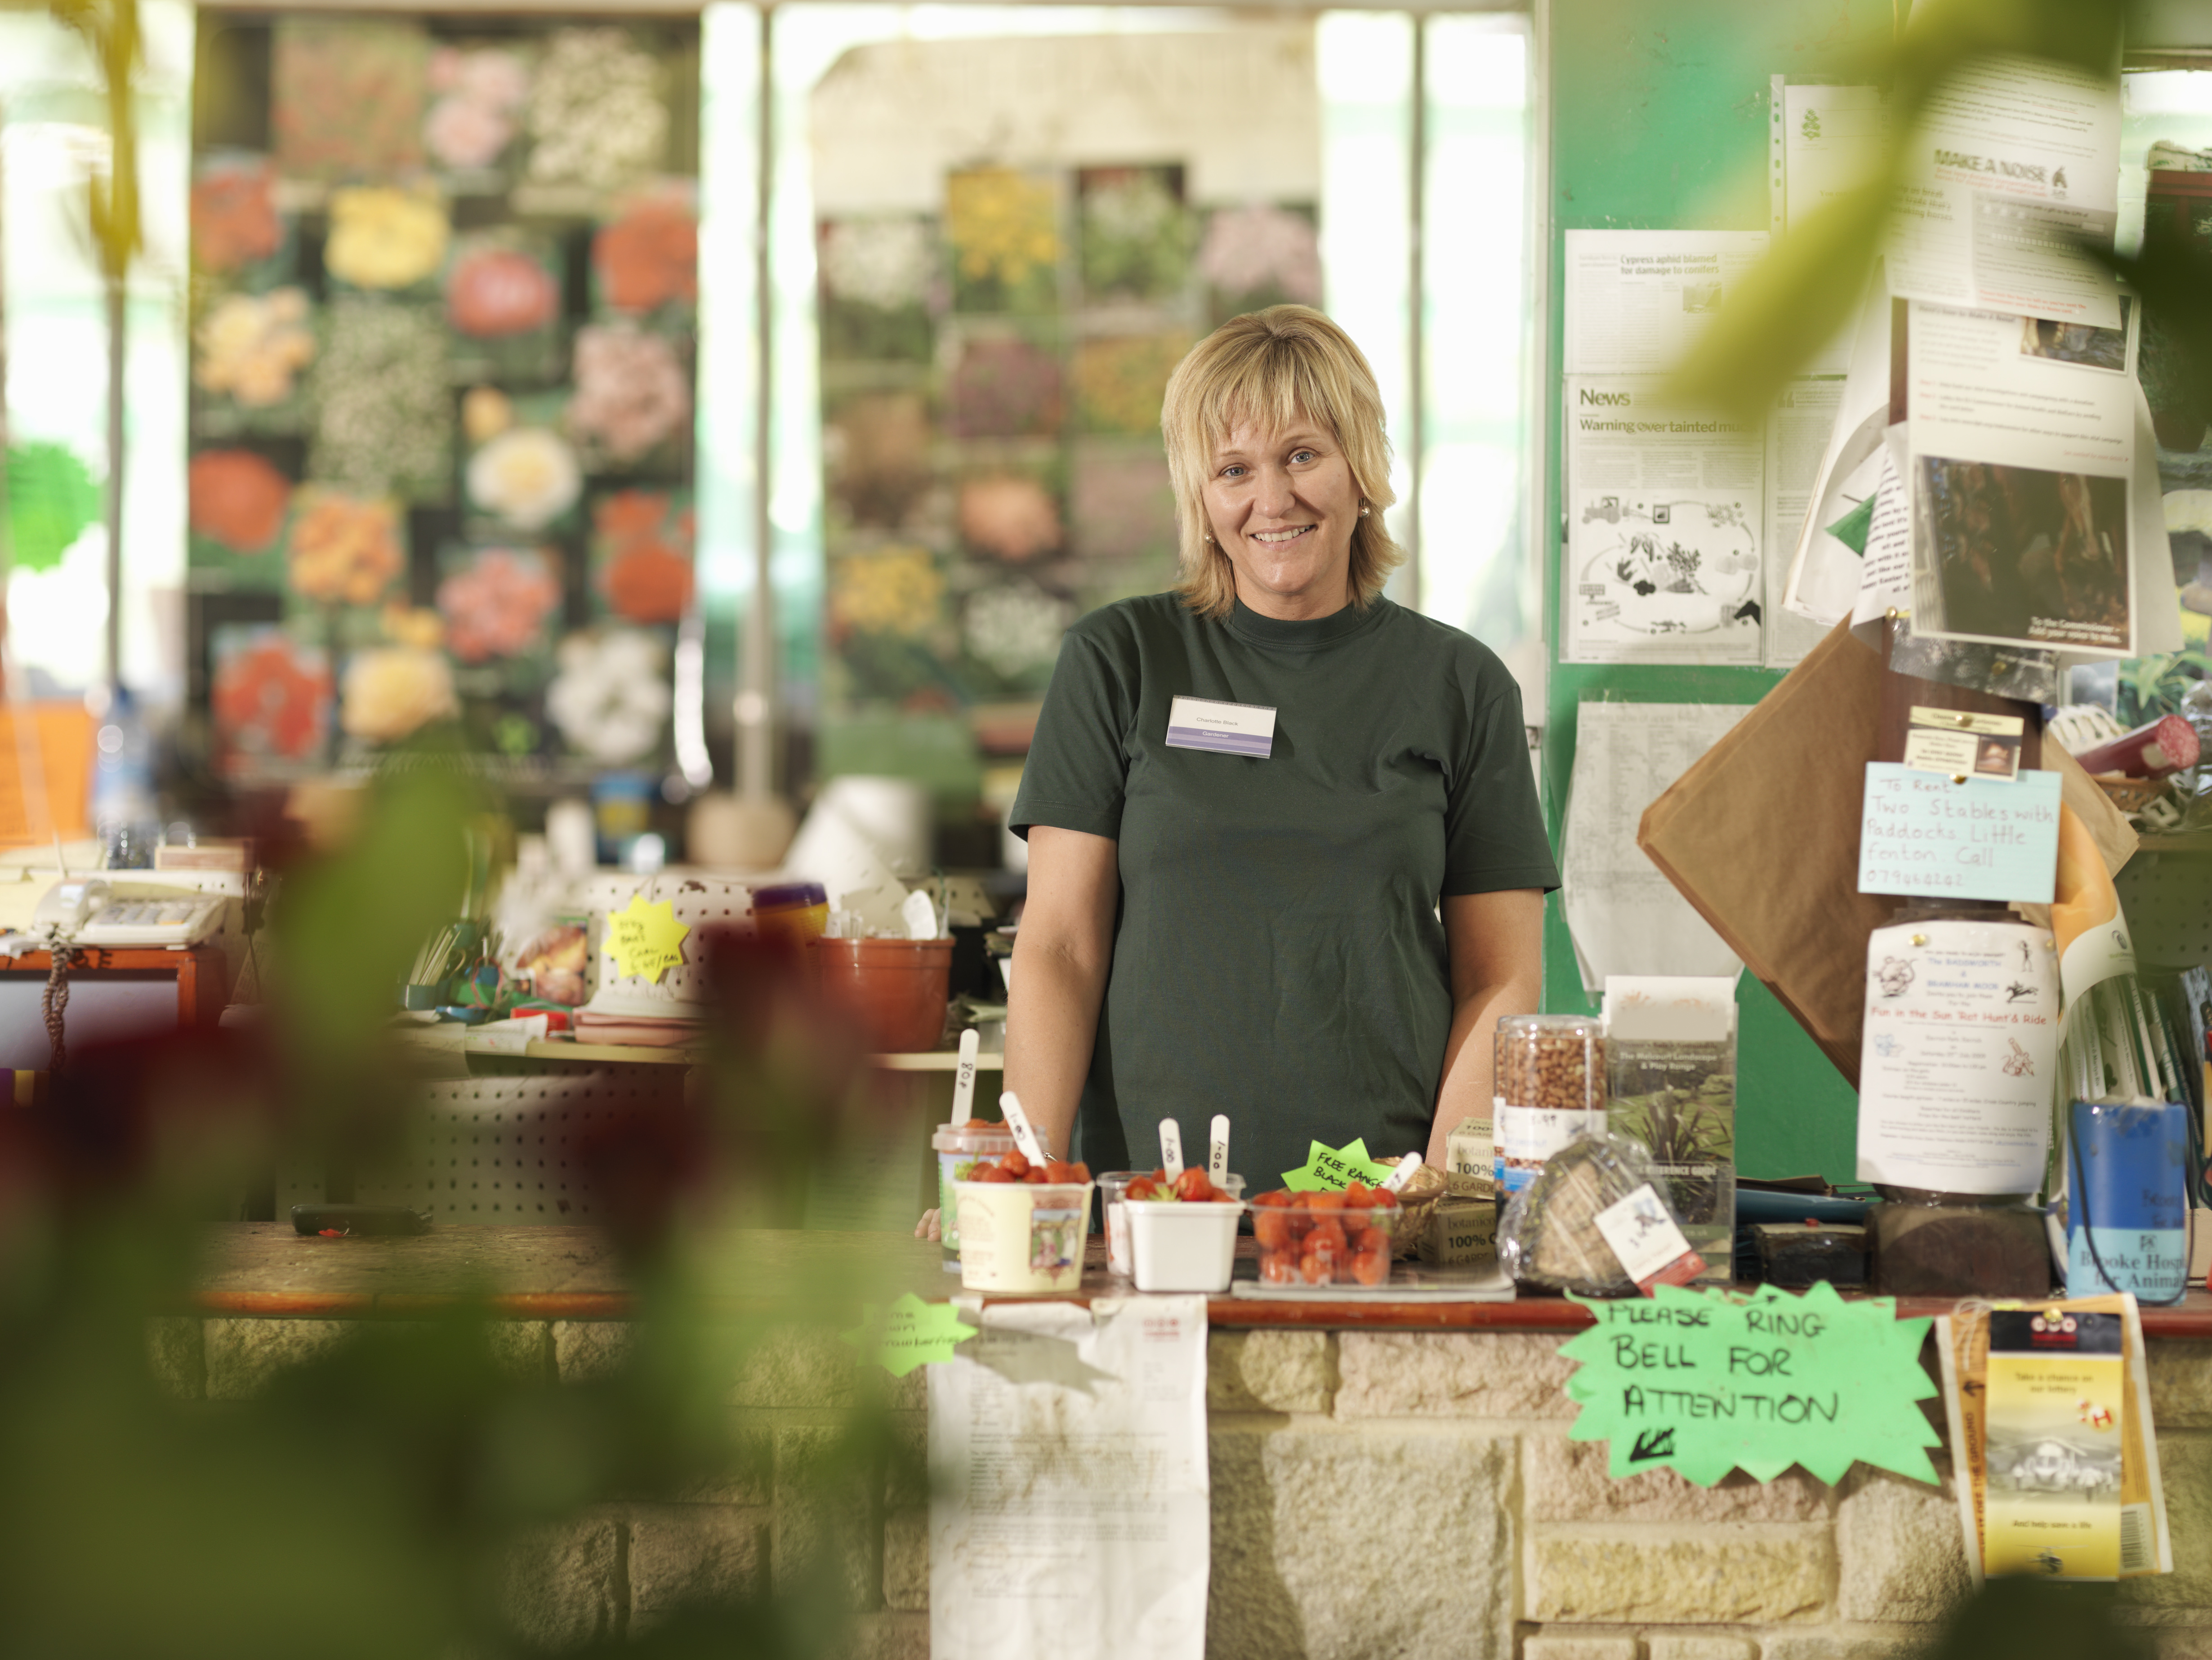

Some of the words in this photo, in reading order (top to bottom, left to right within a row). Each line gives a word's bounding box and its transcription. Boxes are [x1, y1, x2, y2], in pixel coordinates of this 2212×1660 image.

[2001, 161, 2046, 182] NOISE
[1620, 254, 1654, 265] Cypress
[1656, 254, 1681, 264] aphid
[1683, 253, 1717, 263] blamed
[1621, 265, 1632, 274] for
[1636, 266, 1671, 276] damage
[1673, 266, 1682, 274] to
[1685, 264, 1720, 274] conifers
[1580, 388, 1631, 406] News
[1580, 419, 1635, 434] Warning
[1637, 421, 1667, 433] over
[1669, 421, 1717, 433] tainted
[2029, 626, 2046, 636] Add
[2047, 629, 2066, 638] your
[2068, 630, 2089, 639] voice
[2091, 632, 2100, 640] to
[2031, 616, 2043, 625] To
[2044, 618, 2058, 628] the
[2059, 619, 2114, 633] Commissioner
[1879, 778, 1902, 792] To
[1871, 795, 1910, 814] Two
[1928, 799, 2008, 821] Stables
[2014, 804, 2055, 823] with
[1970, 824, 2027, 845] Little
[1955, 846, 1993, 867] Call
[1872, 1007, 1891, 1017] Fun
[1895, 1008, 1906, 1017] in
[1909, 1009, 1927, 1019] the
[1932, 1011, 1952, 1021] Sun
[2024, 1014, 2047, 1025] Ride
[1620, 1052, 1635, 1060] The
[1673, 1053, 1717, 1062] Landscape
[2087, 1026, 2096, 1048] Phillips
[2092, 1055, 2101, 1076] Martyn
[1649, 1062, 1668, 1071] Play
[1669, 1062, 1696, 1072] Range
[1317, 1152, 1346, 1172] FREE
[1456, 1162, 1494, 1177] 100%
[1313, 1166, 1347, 1190] BLACK
[1691, 1166, 1717, 1176] GUIDE
[1453, 1181, 1459, 1191] 6
[1449, 1235, 1486, 1249] 100%
[1609, 1305, 1712, 1328] PLEASE
[1745, 1309, 1827, 1338] RING
[1610, 1334, 1697, 1369] BELL
[1729, 1347, 1793, 1376] FOR
[2015, 1373, 2035, 1381] Take
[2047, 1373, 2078, 1382] chance
[2030, 1385, 2045, 1393] our
[2047, 1384, 2078, 1395] lottery
[1624, 1384, 1839, 1424] ATTENTION
[1965, 1412, 1980, 1464] GROUND
[1971, 1465, 1982, 1488] THE
[2013, 1520, 2030, 1528] And
[2032, 1520, 2048, 1530] help
[2078, 1521, 2092, 1529] life
